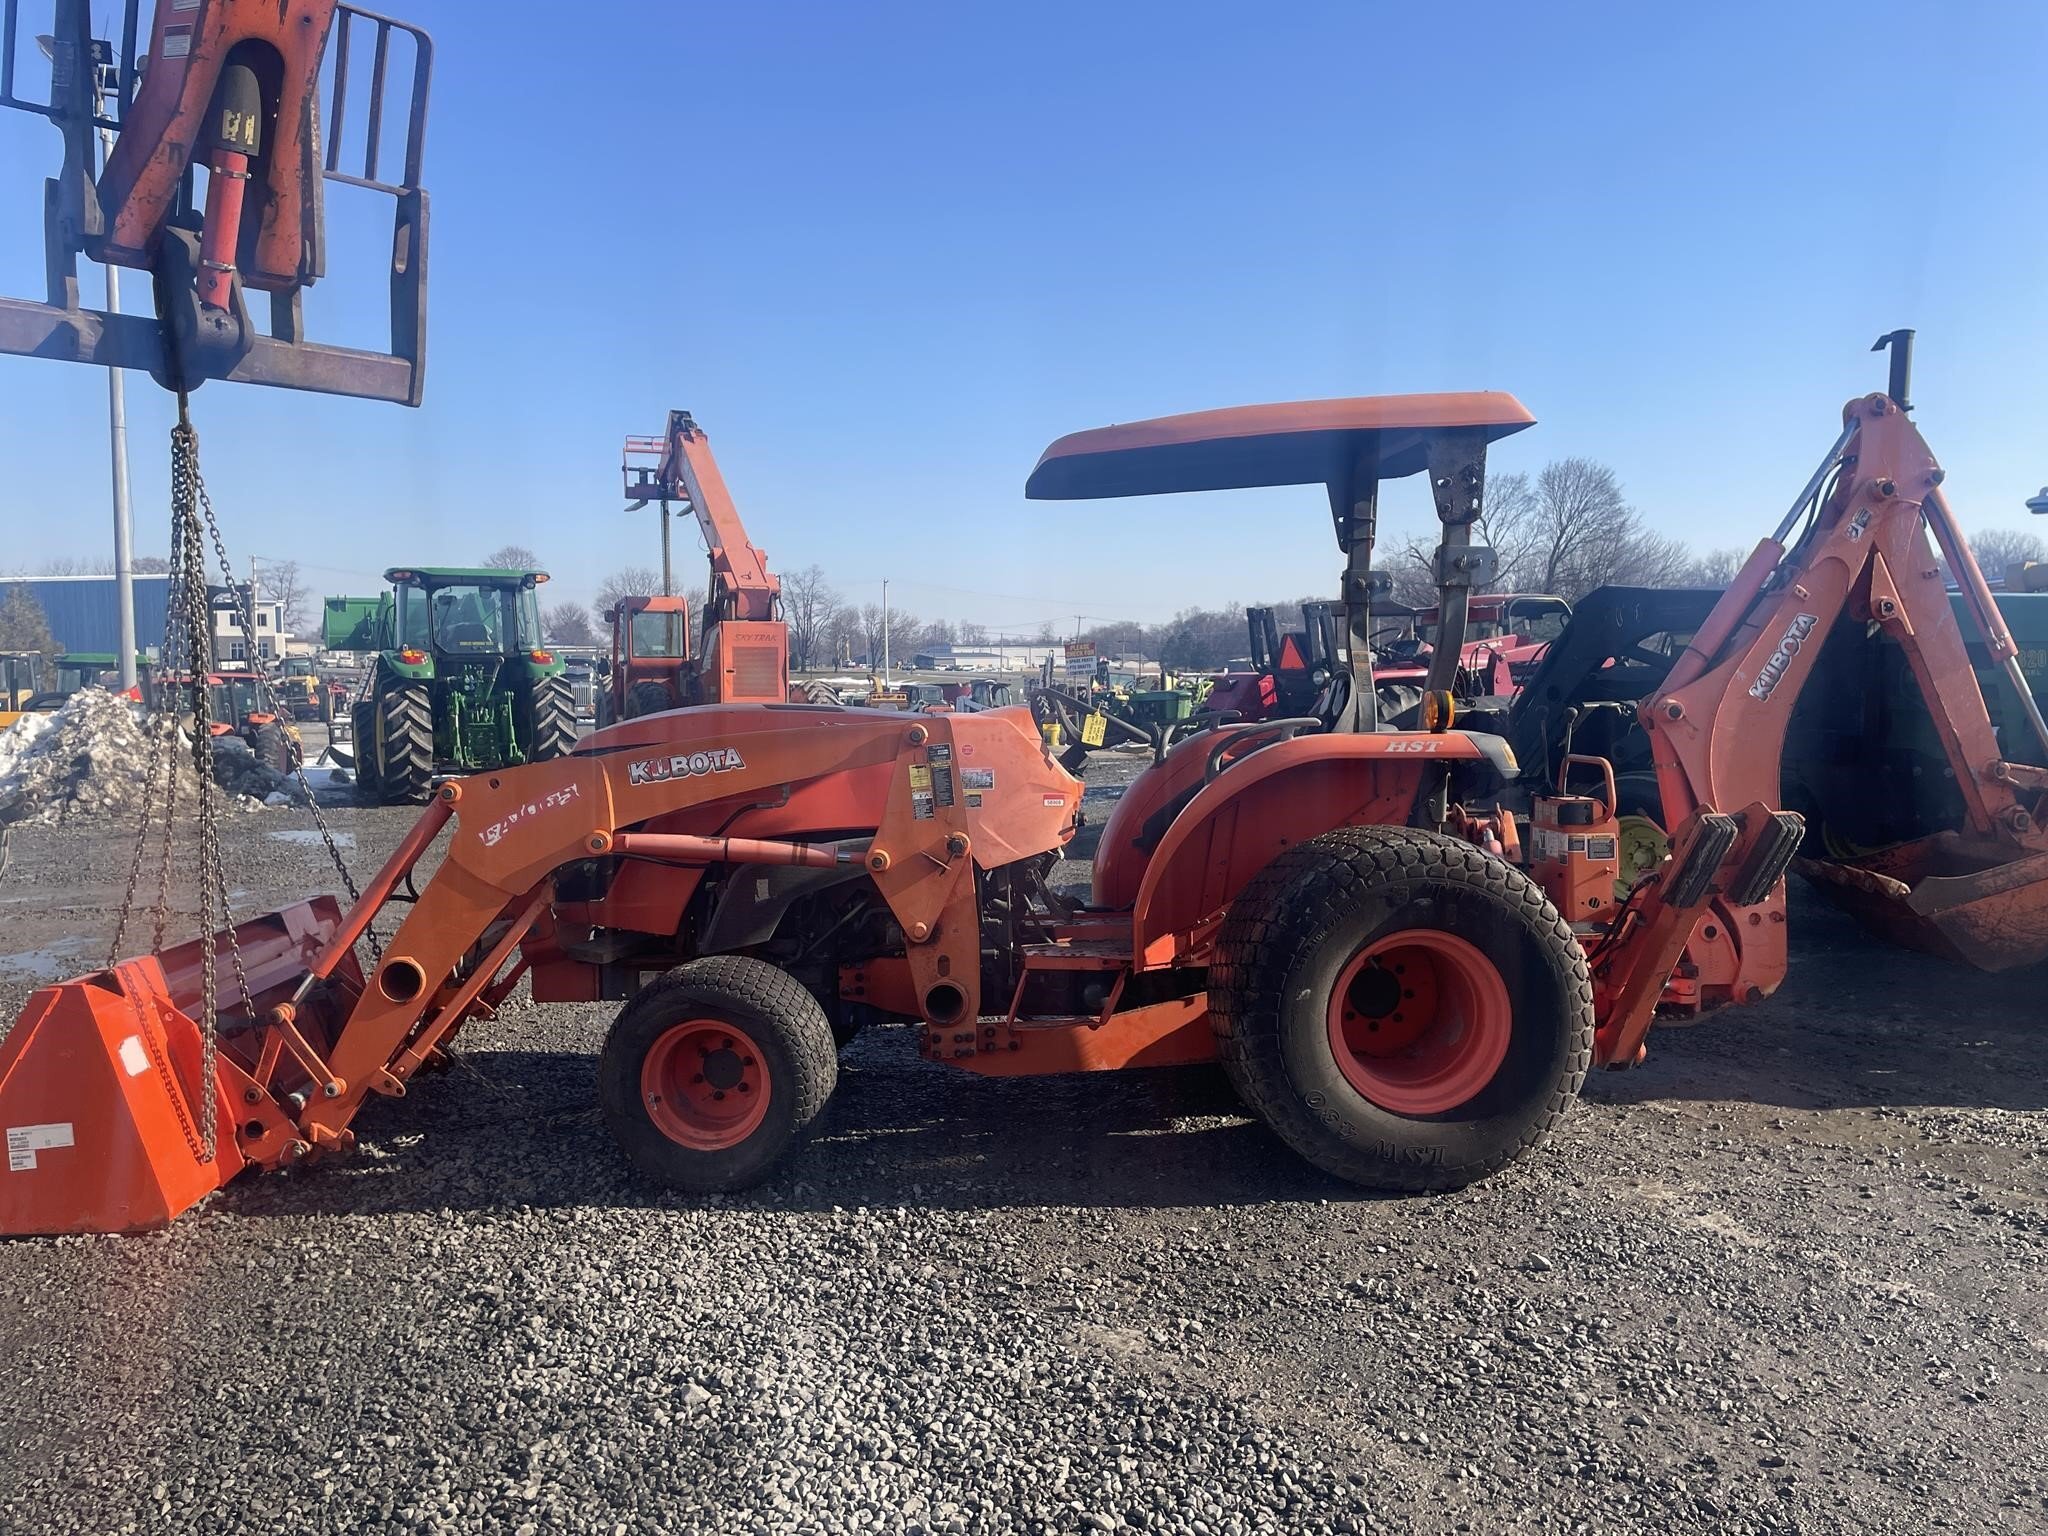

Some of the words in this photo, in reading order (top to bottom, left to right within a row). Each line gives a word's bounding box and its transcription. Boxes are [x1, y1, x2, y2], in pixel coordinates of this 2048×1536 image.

[1749, 613, 1819, 703] KUBOTA
[628, 747, 746, 786] KUBOTA
[1384, 741, 1444, 753] HST
